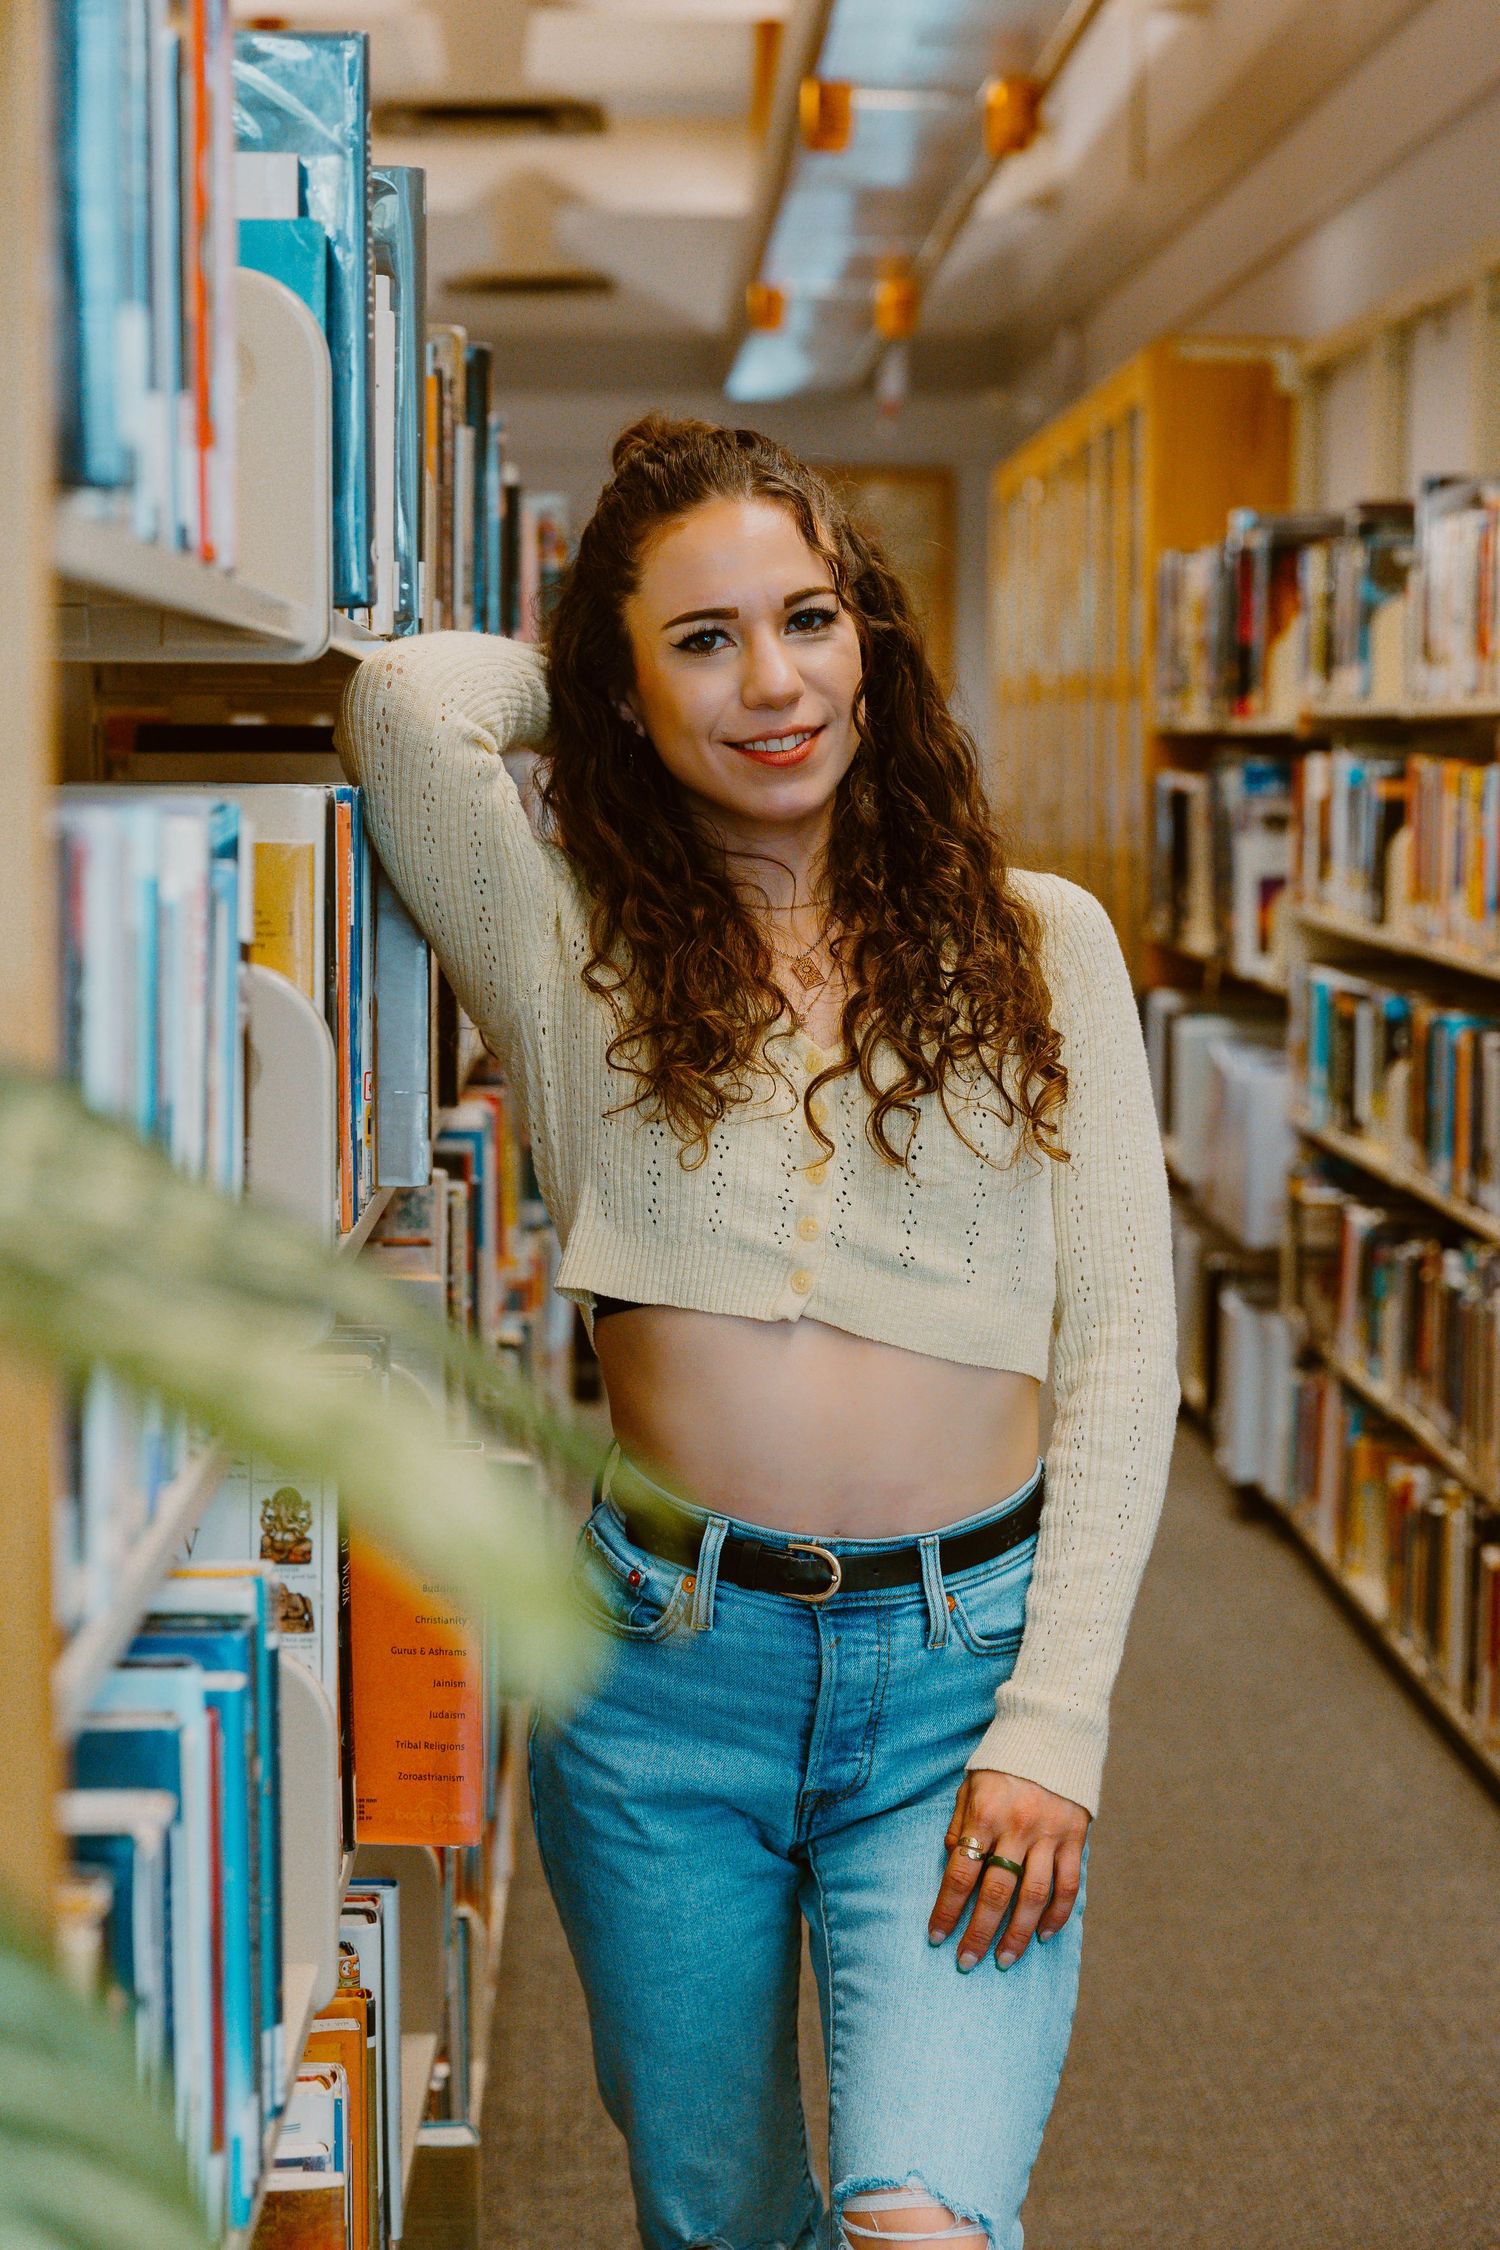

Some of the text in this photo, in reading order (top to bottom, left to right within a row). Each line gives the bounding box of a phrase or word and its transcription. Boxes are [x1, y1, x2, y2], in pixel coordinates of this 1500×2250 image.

[342, 1560, 351, 1607] WORK
[415, 1615, 468, 1626] Christianity
[390, 1646, 467, 1657] Gurus & Ashrams
[433, 1679, 466, 1688] Jainism
[429, 1710, 466, 1720] Judaism
[395, 1740, 465, 1753] Tribal Religions
[398, 1771, 465, 1782] Zoroastrianism
